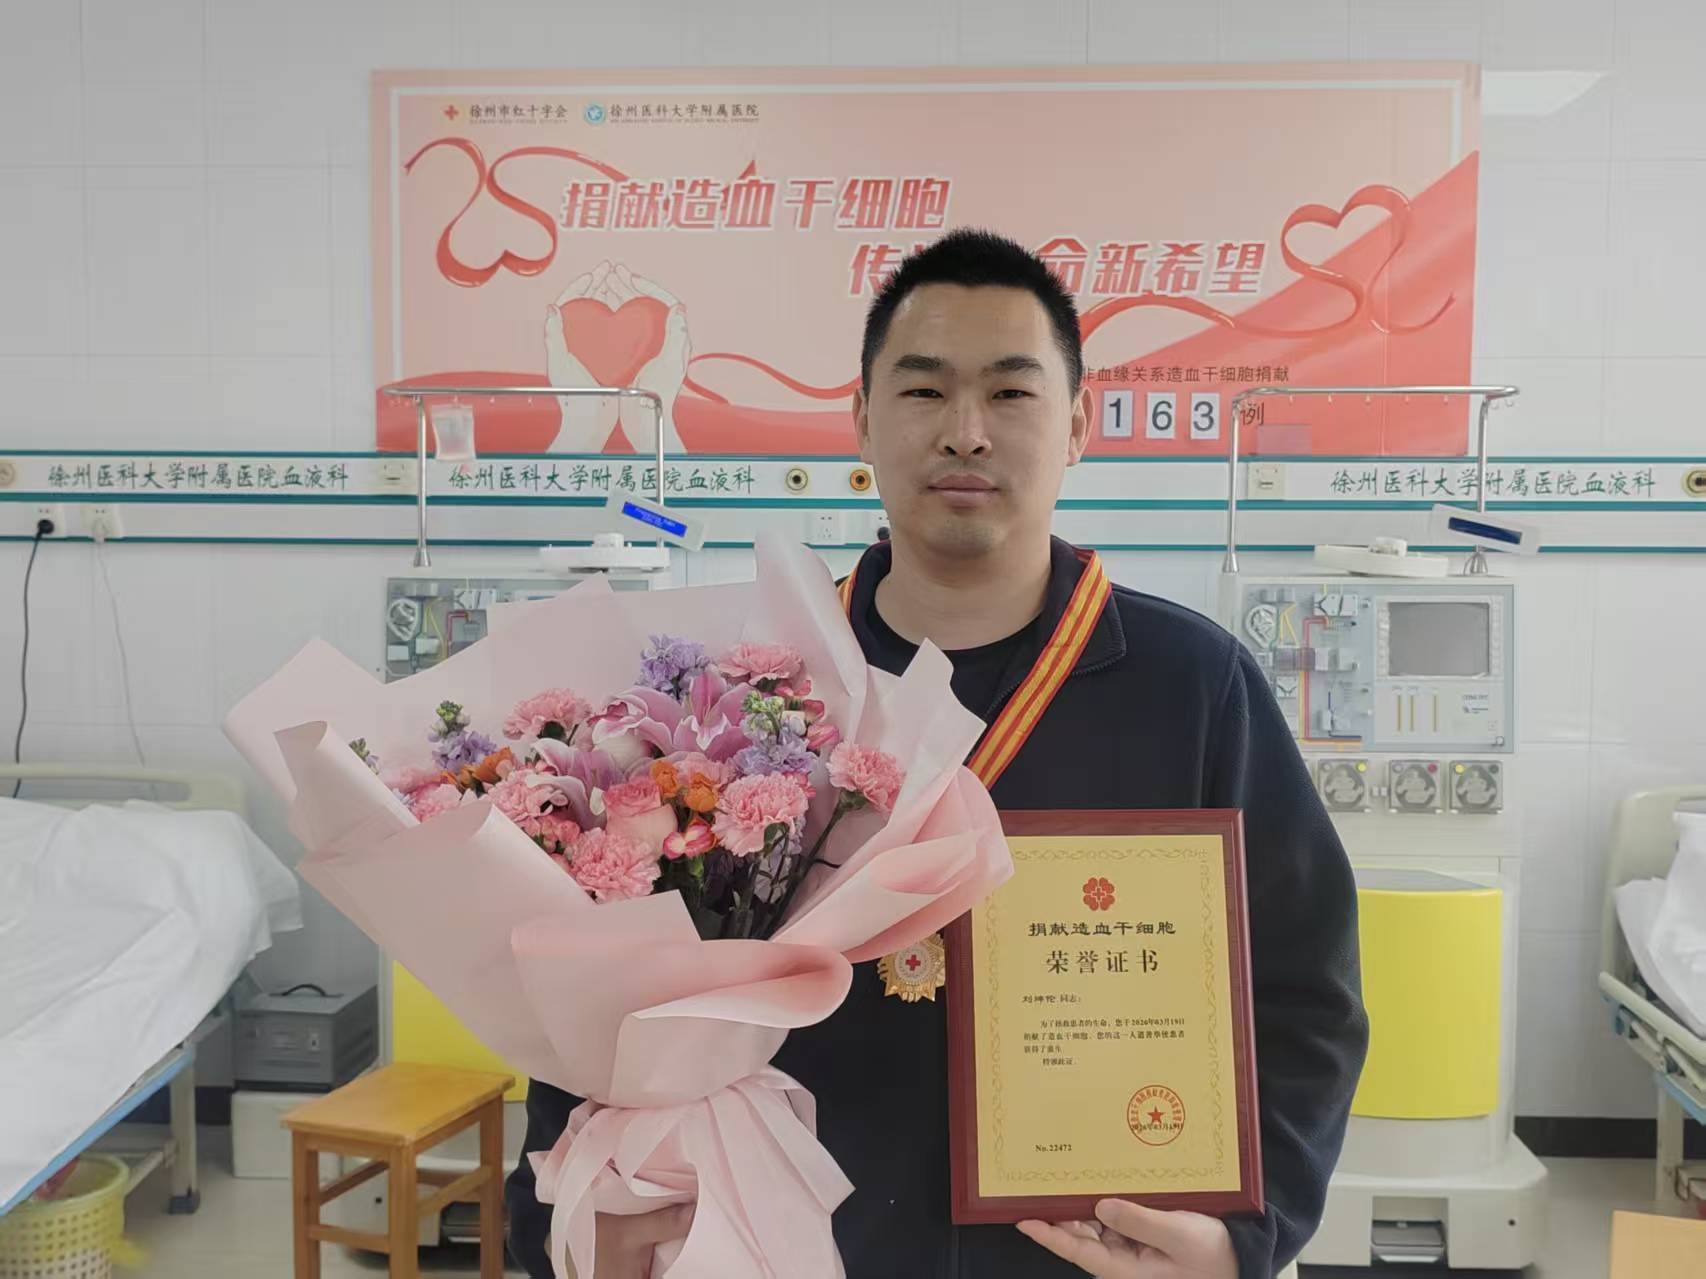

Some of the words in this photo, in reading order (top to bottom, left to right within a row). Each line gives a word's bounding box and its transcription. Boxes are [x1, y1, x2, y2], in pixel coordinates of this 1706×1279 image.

[470, 103, 568, 118] 徐州市红十字会
[610, 103, 760, 118] 徐州医科大学附属医院
[560, 176, 952, 231] 捐献造血干细胞
[48, 461, 349, 491] 徐州医科大学附属医院血液科
[448, 464, 756, 494] 徐州医科大学附属医院血液科
[1330, 467, 1656, 497] 徐州医科大学附属医院血液科
[1028, 921, 1177, 937] 捐献造血干细胞
[1046, 949, 1159, 974] 荣誉证书
